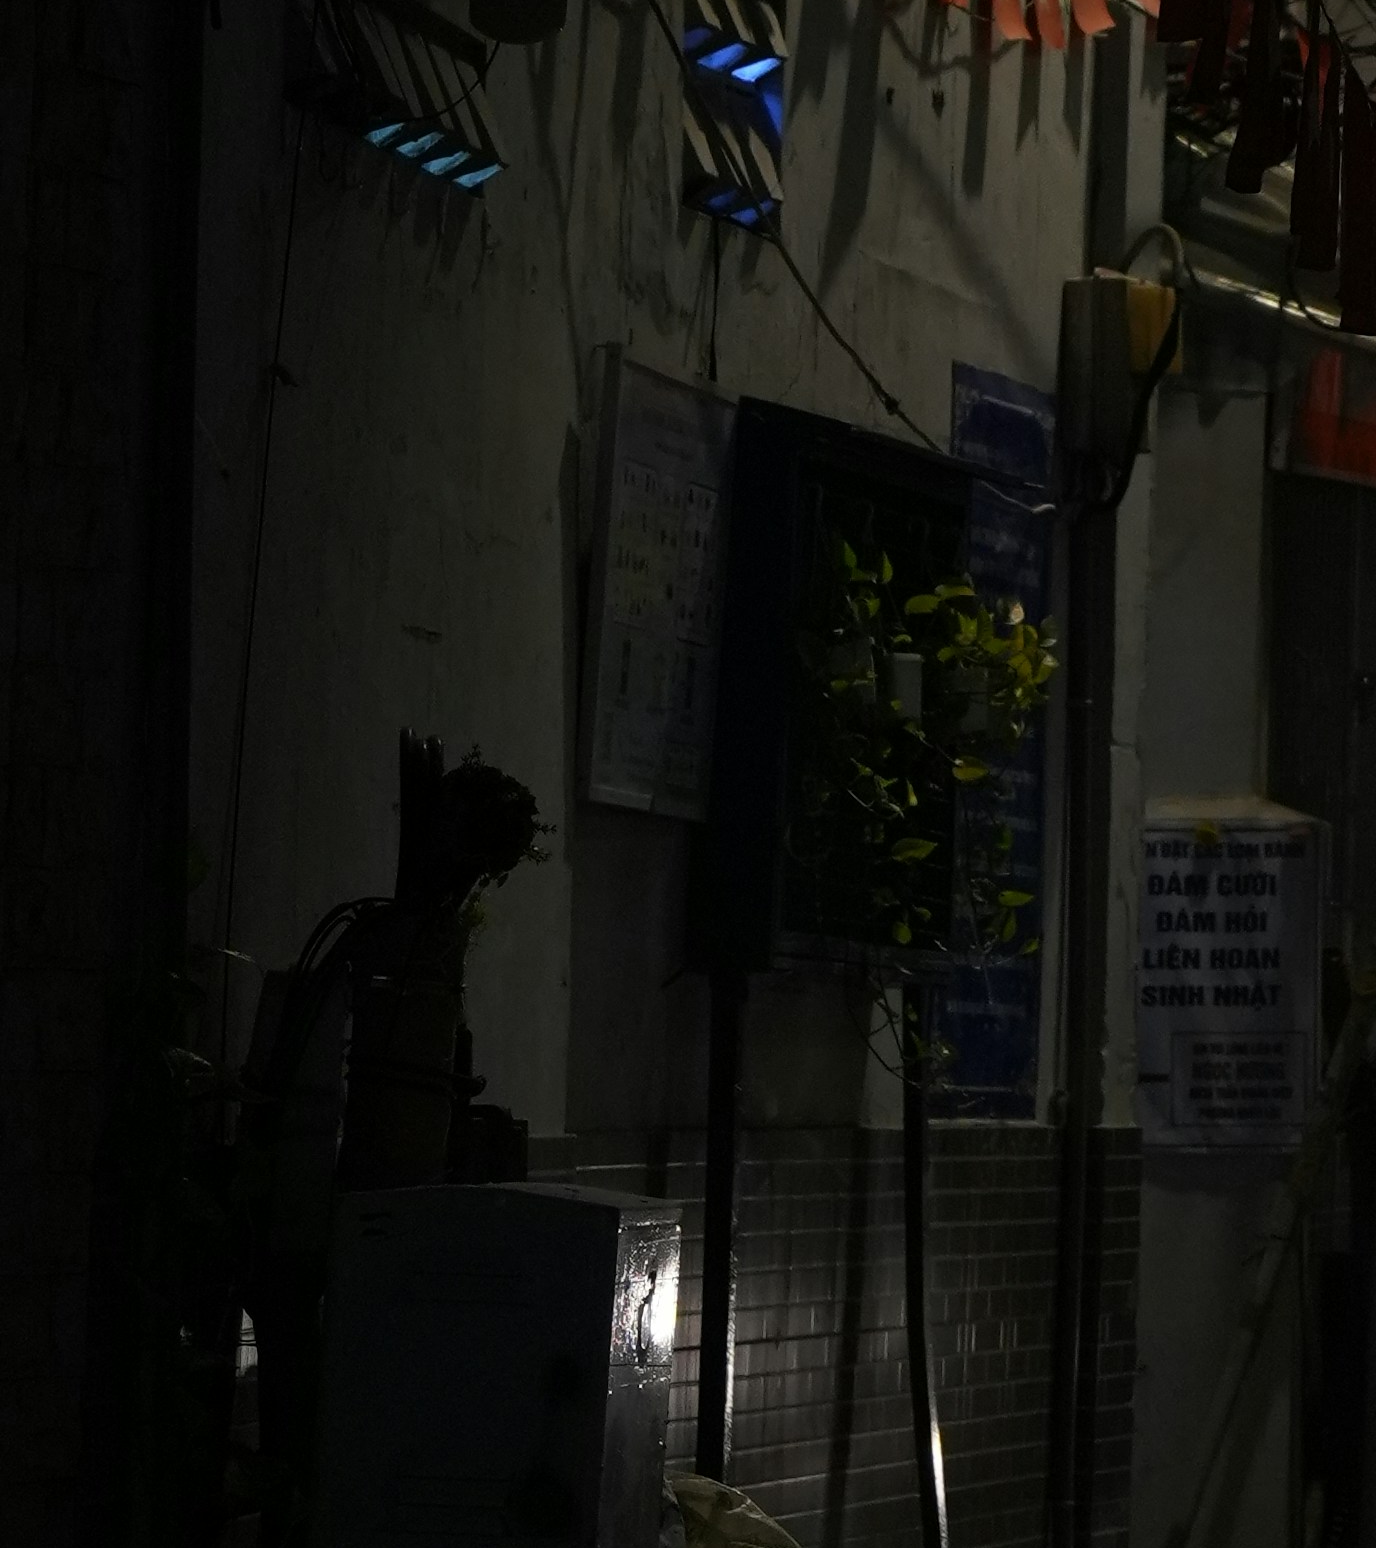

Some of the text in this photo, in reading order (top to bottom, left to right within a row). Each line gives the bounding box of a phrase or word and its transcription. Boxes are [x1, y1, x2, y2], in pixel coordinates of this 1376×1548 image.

[1148, 870, 1276, 896] ĐÁM CƯỚI
[1157, 904, 1267, 933] ĐÁM HỎI
[1143, 943, 1280, 969] LIÊN HOAN
[1141, 980, 1281, 1011] SINH NHẬT
